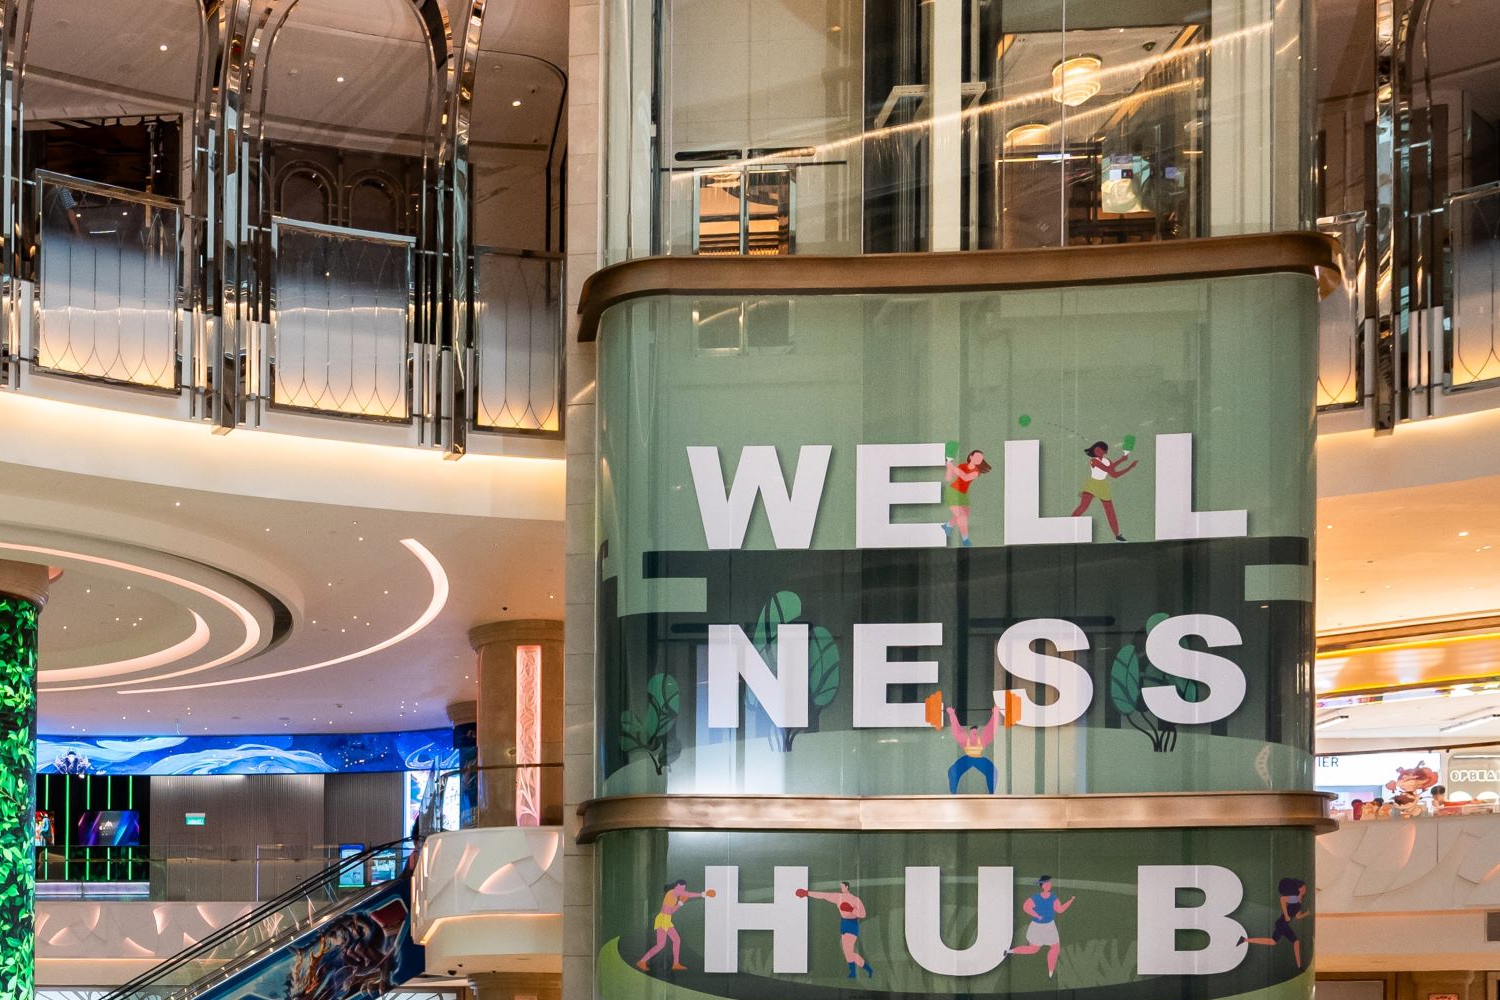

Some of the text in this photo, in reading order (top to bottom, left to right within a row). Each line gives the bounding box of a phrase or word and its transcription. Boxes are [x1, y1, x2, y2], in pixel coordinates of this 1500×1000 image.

[686, 432, 1249, 549] WELL
[707, 614, 1247, 729] NESS
[704, 865, 1249, 977] HUB
